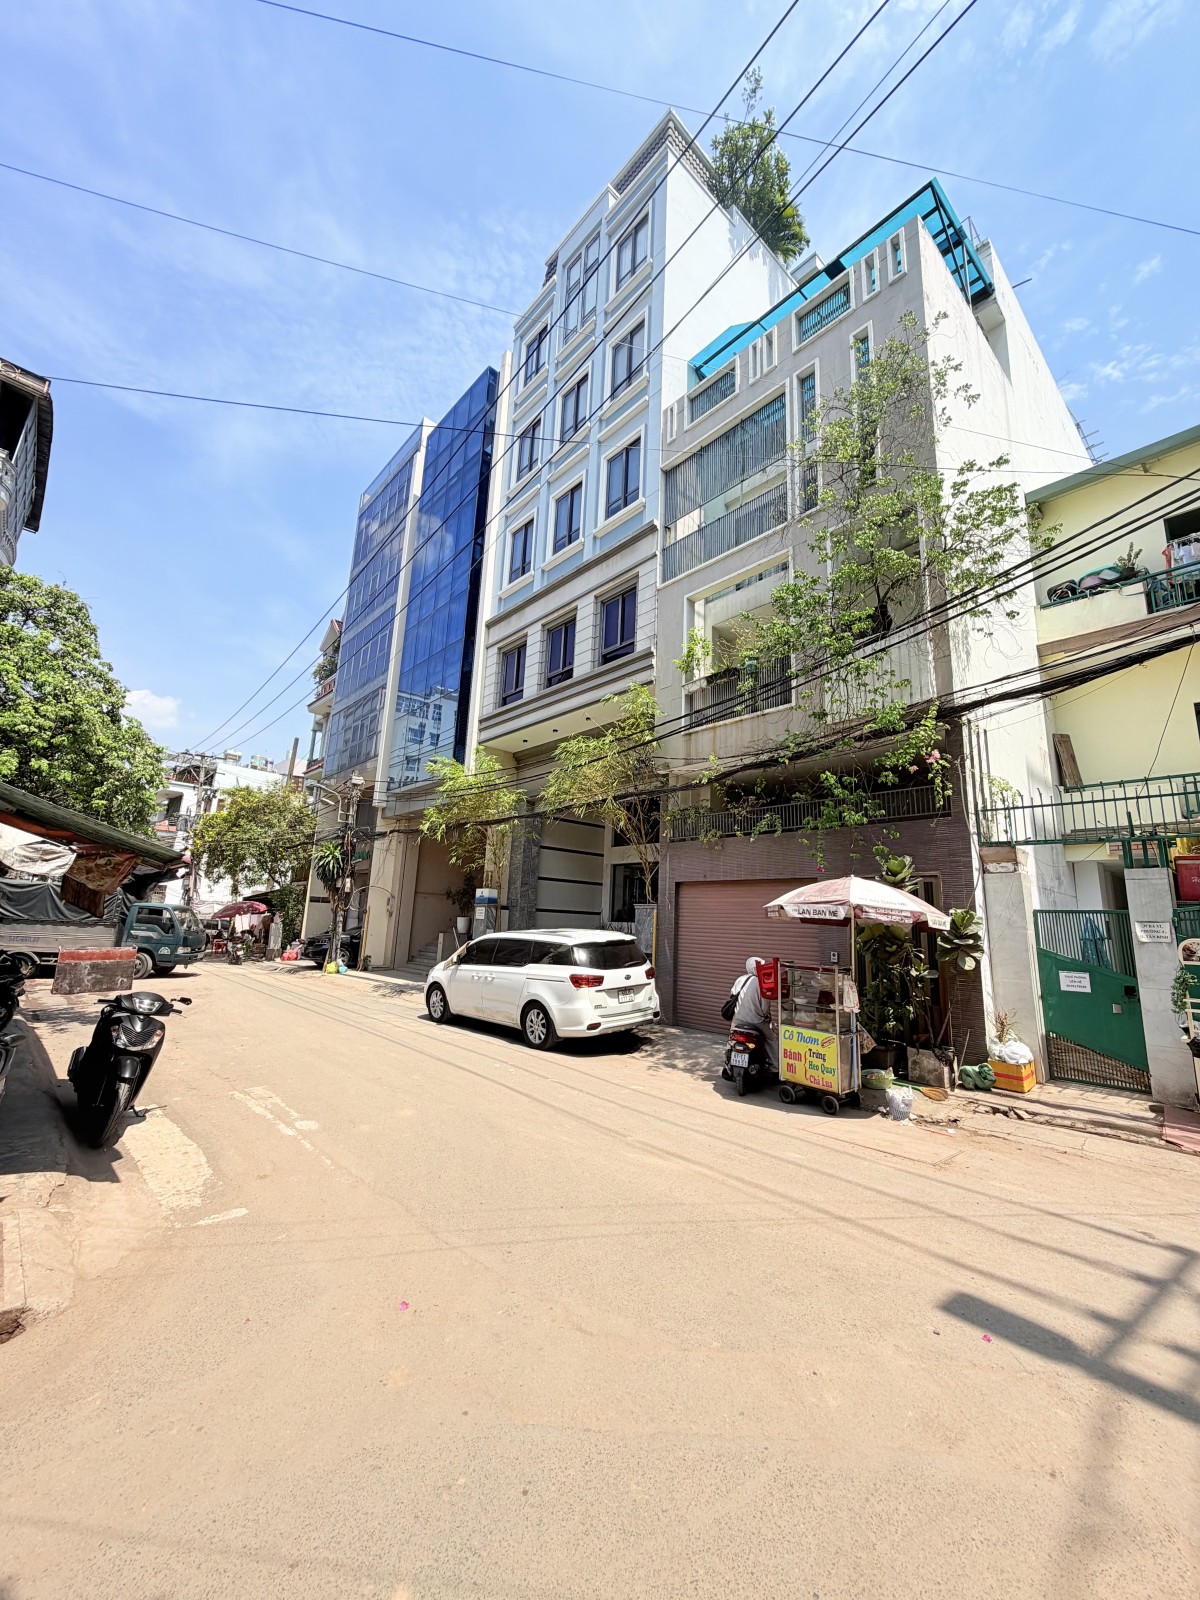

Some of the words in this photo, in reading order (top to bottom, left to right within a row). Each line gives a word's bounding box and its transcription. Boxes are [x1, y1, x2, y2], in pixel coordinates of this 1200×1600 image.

[797, 908, 811, 916] LAN
[812, 908, 827, 916] BAN
[783, 1029, 794, 1041] Cô
[796, 1031, 819, 1046] Thơm
[783, 1048, 802, 1062] Bánh
[808, 1048, 826, 1062] Trứng
[808, 1060, 819, 1071] Heo
[820, 1063, 836, 1077] Quay
